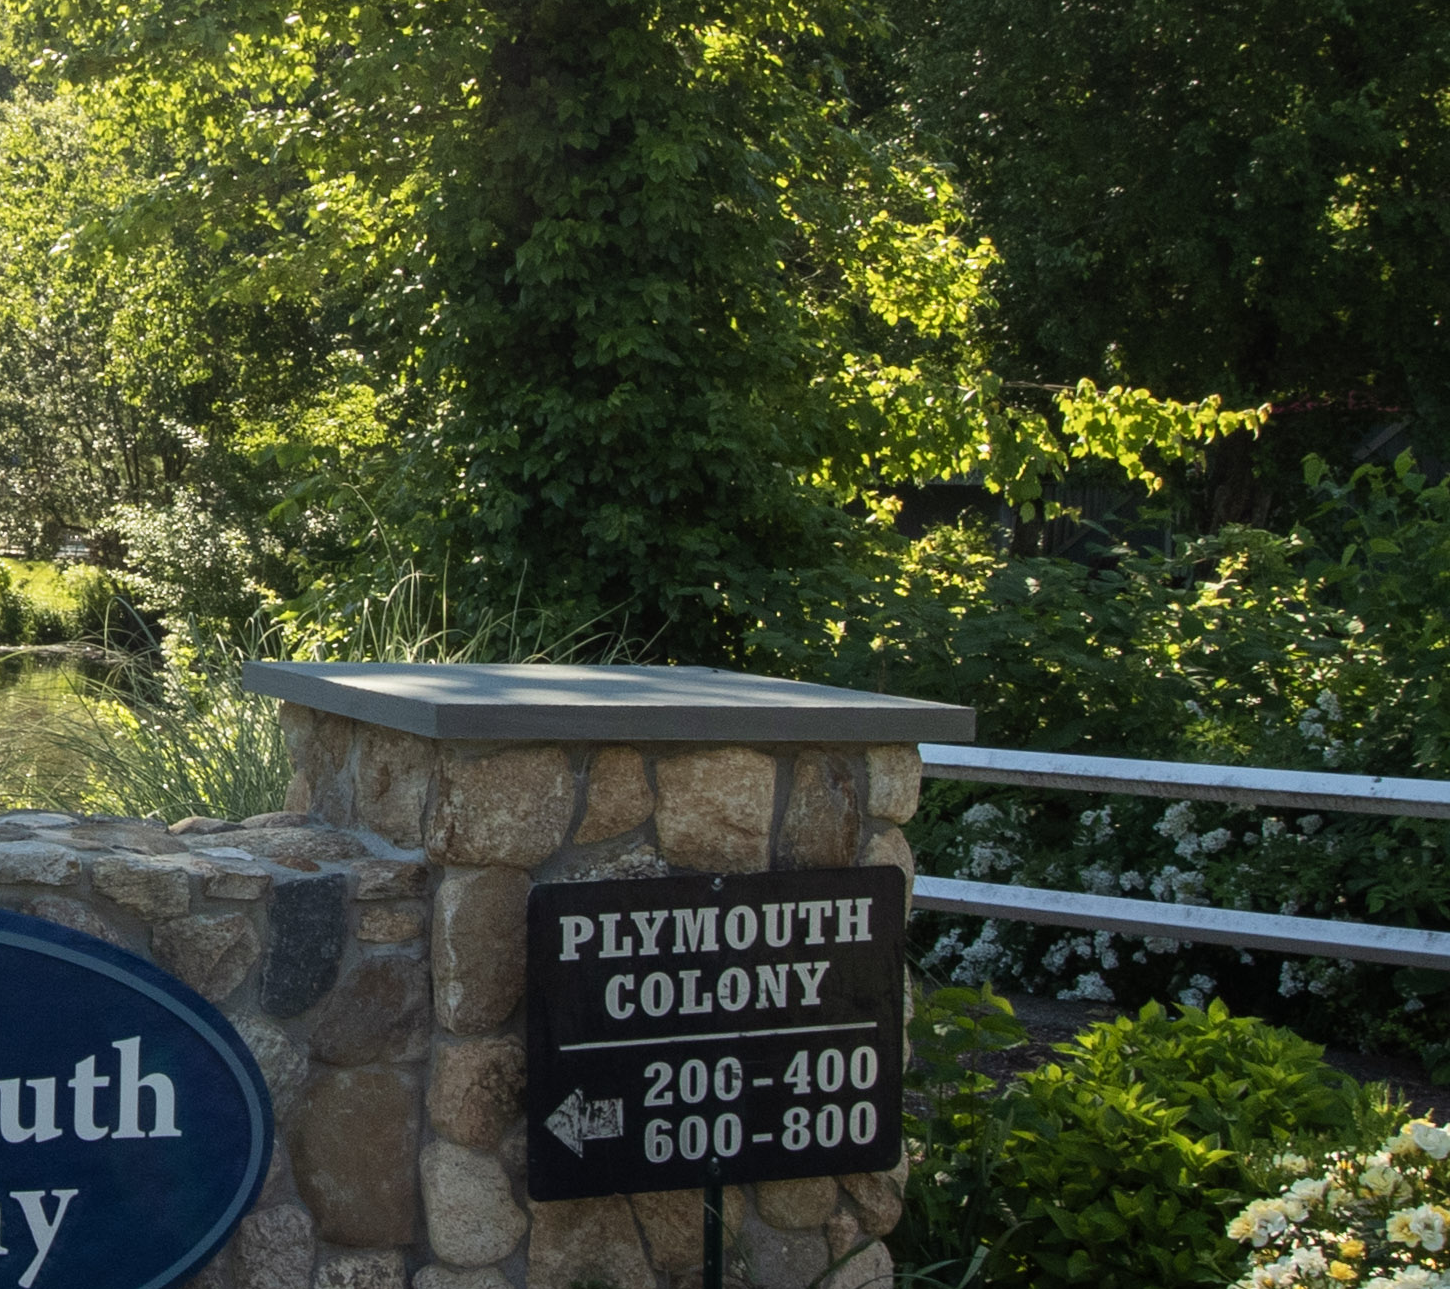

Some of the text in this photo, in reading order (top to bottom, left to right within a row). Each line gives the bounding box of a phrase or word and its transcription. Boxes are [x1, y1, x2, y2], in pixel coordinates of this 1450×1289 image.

[559, 897, 873, 961] PLYMOUTH
[605, 960, 831, 1020] COLONY
[644, 1045, 879, 1107] 200-400
[644, 1101, 878, 1163] 600-800
